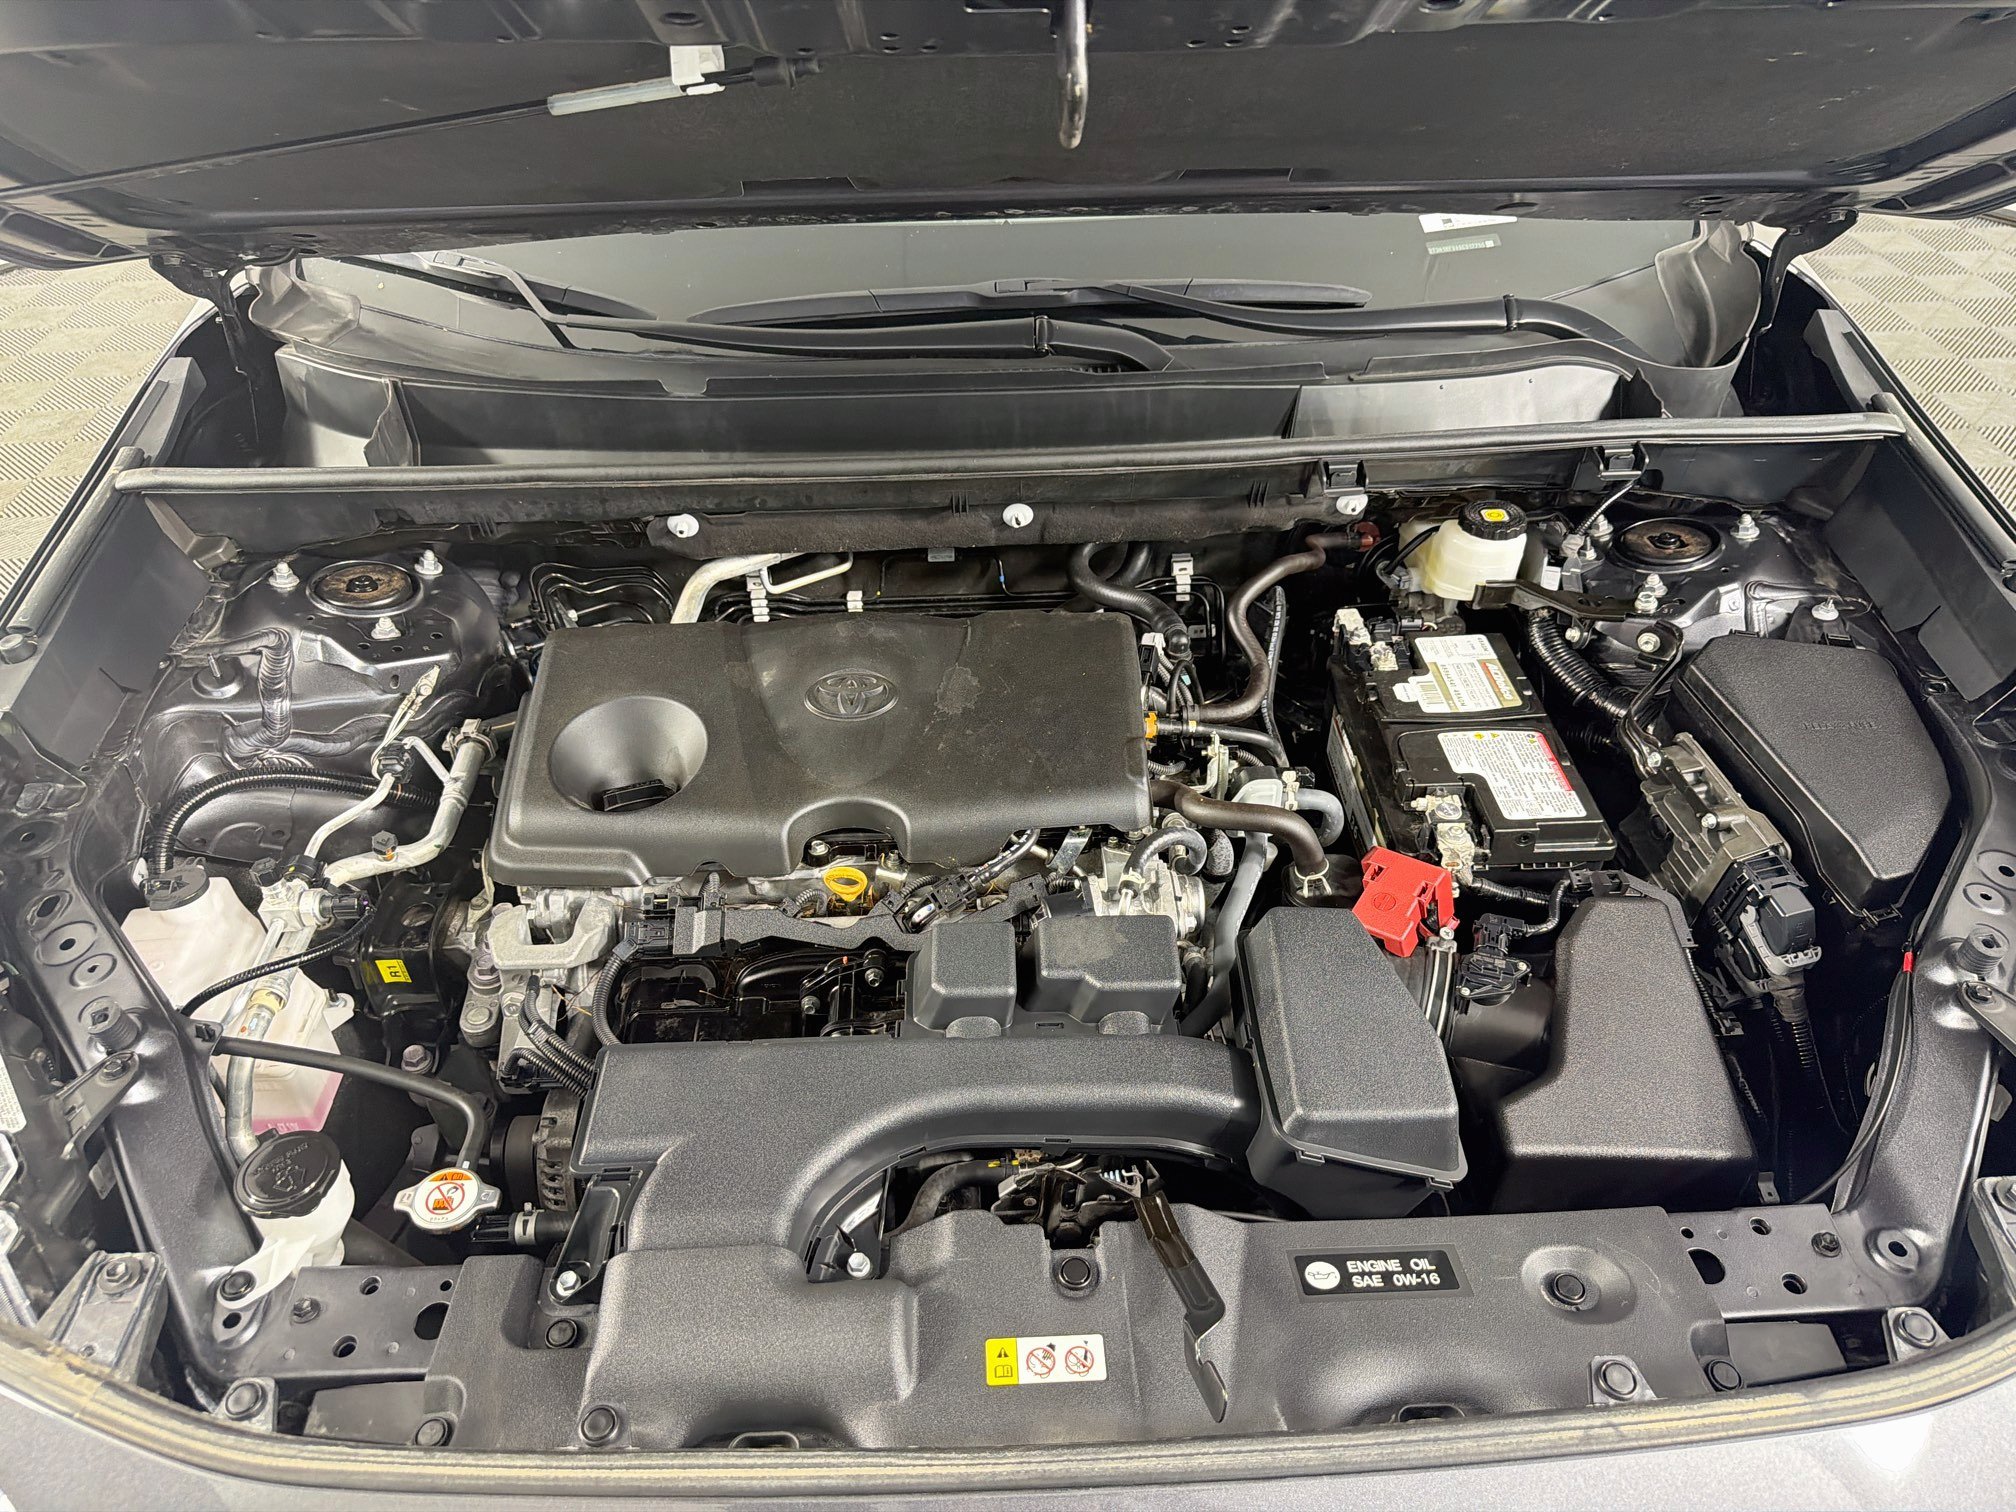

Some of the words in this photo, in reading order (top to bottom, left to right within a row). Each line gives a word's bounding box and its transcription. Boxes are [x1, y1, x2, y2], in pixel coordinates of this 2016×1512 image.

[386, 965, 402, 978] R1
[1346, 1259, 1402, 1273] ENGINE
[1410, 1258, 1437, 1271] OIL
[1351, 1274, 1385, 1288] SAE
[1393, 1272, 1441, 1287] 0W-16
